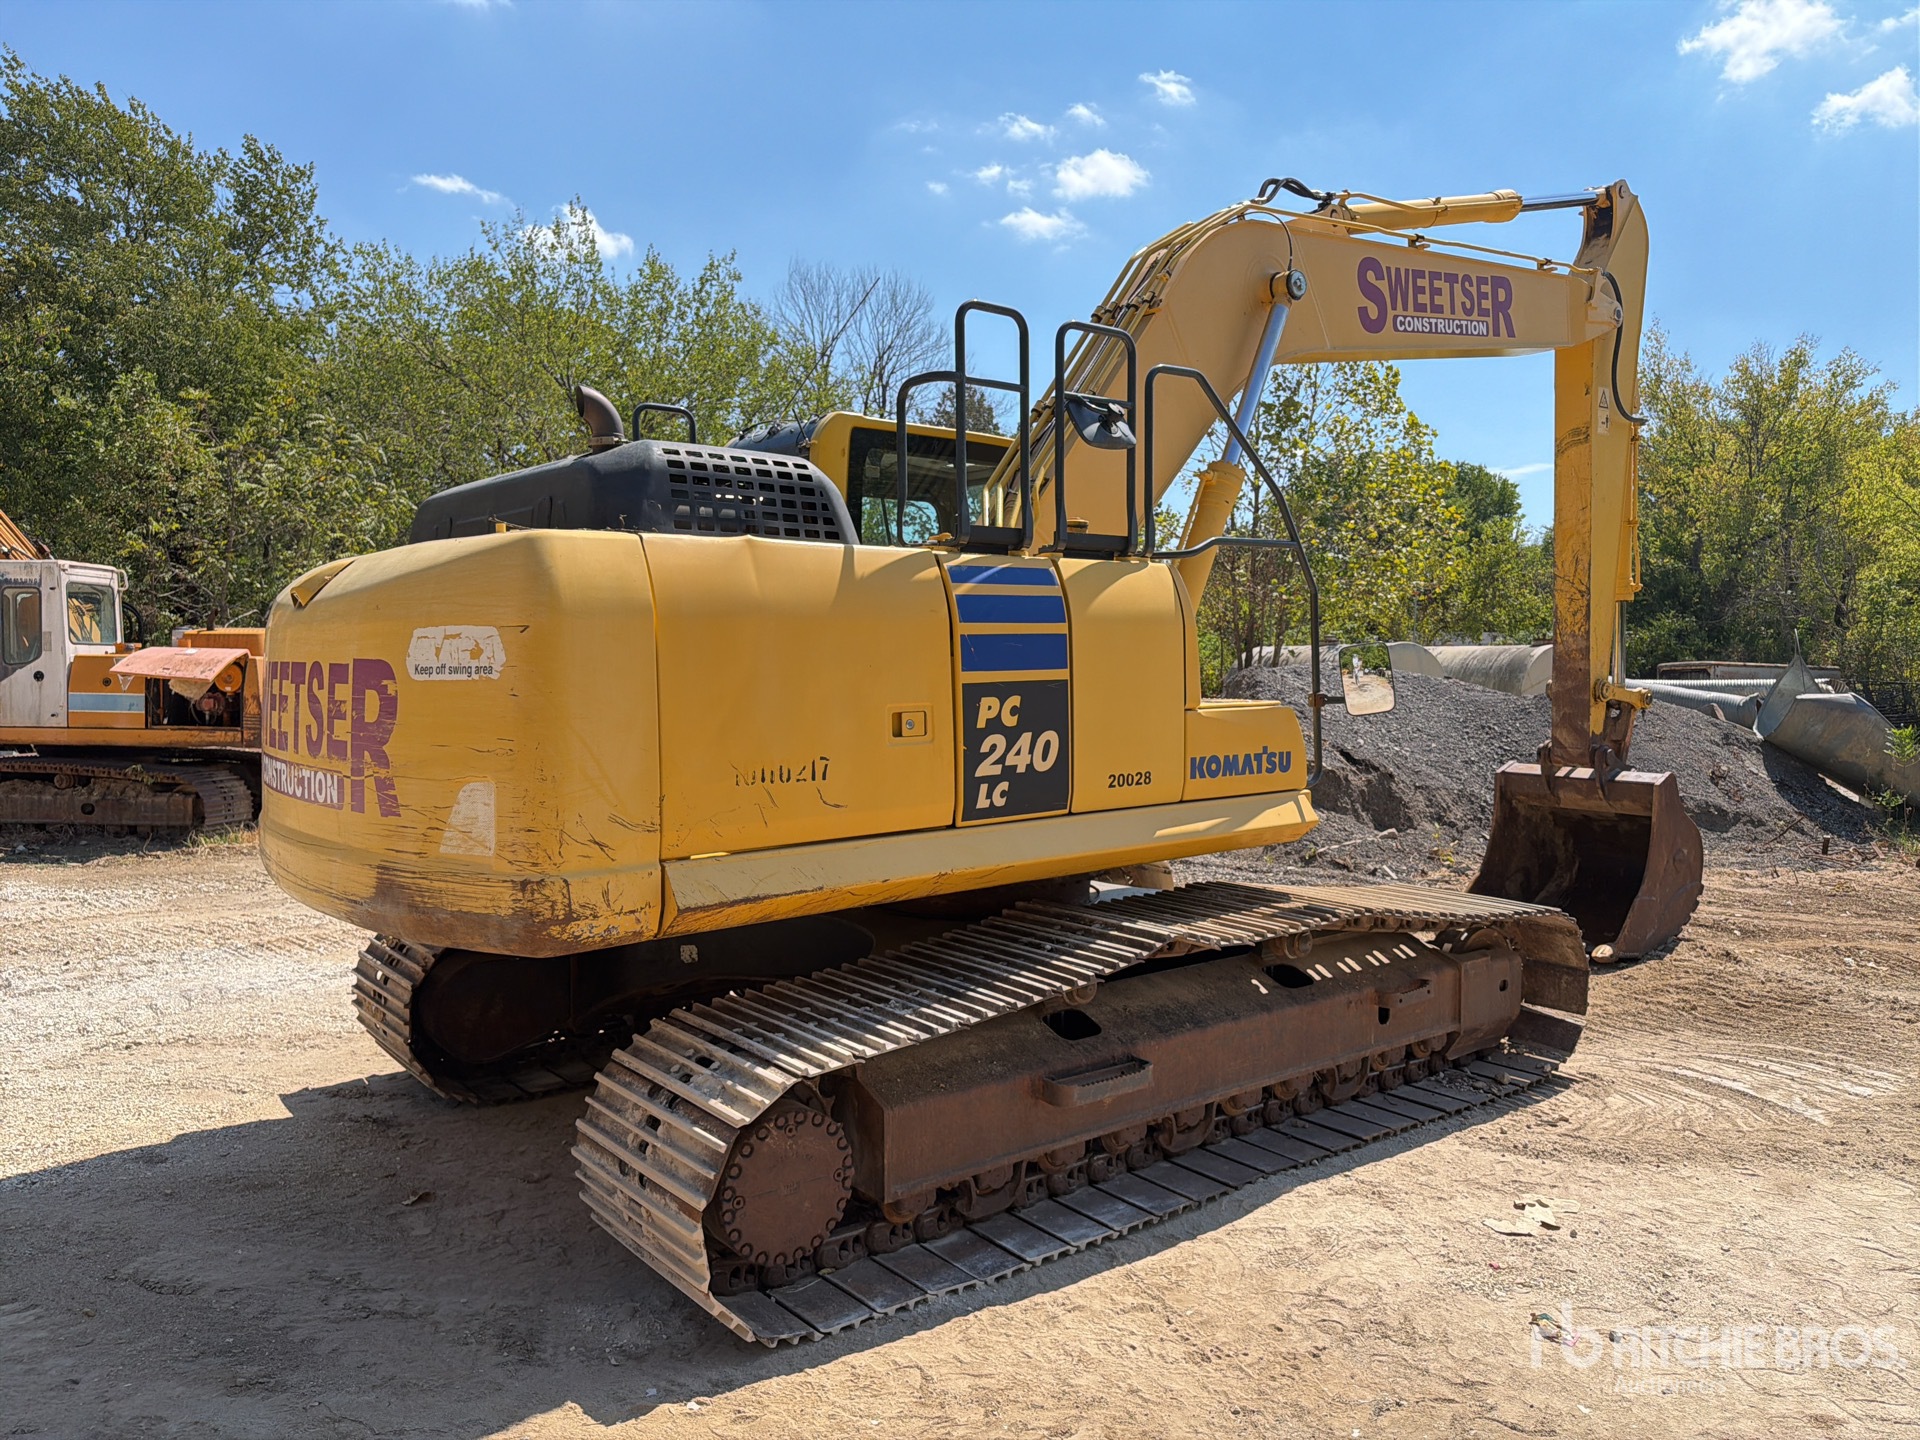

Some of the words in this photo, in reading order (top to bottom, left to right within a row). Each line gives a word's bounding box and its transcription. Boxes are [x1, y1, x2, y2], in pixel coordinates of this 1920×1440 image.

[1357, 256, 1516, 338] SWEETSER
[1396, 316, 1487, 336] CONSTRUCTION
[414, 663, 434, 678] Keep
[435, 663, 446, 675] off
[448, 665, 472, 678] swing
[474, 665, 493, 675] area
[976, 695, 1022, 729] PC
[974, 730, 1060, 777] 240
[1190, 746, 1291, 780] KOMATSU
[975, 781, 1010, 809] LC
[1107, 771, 1152, 789] 20028
